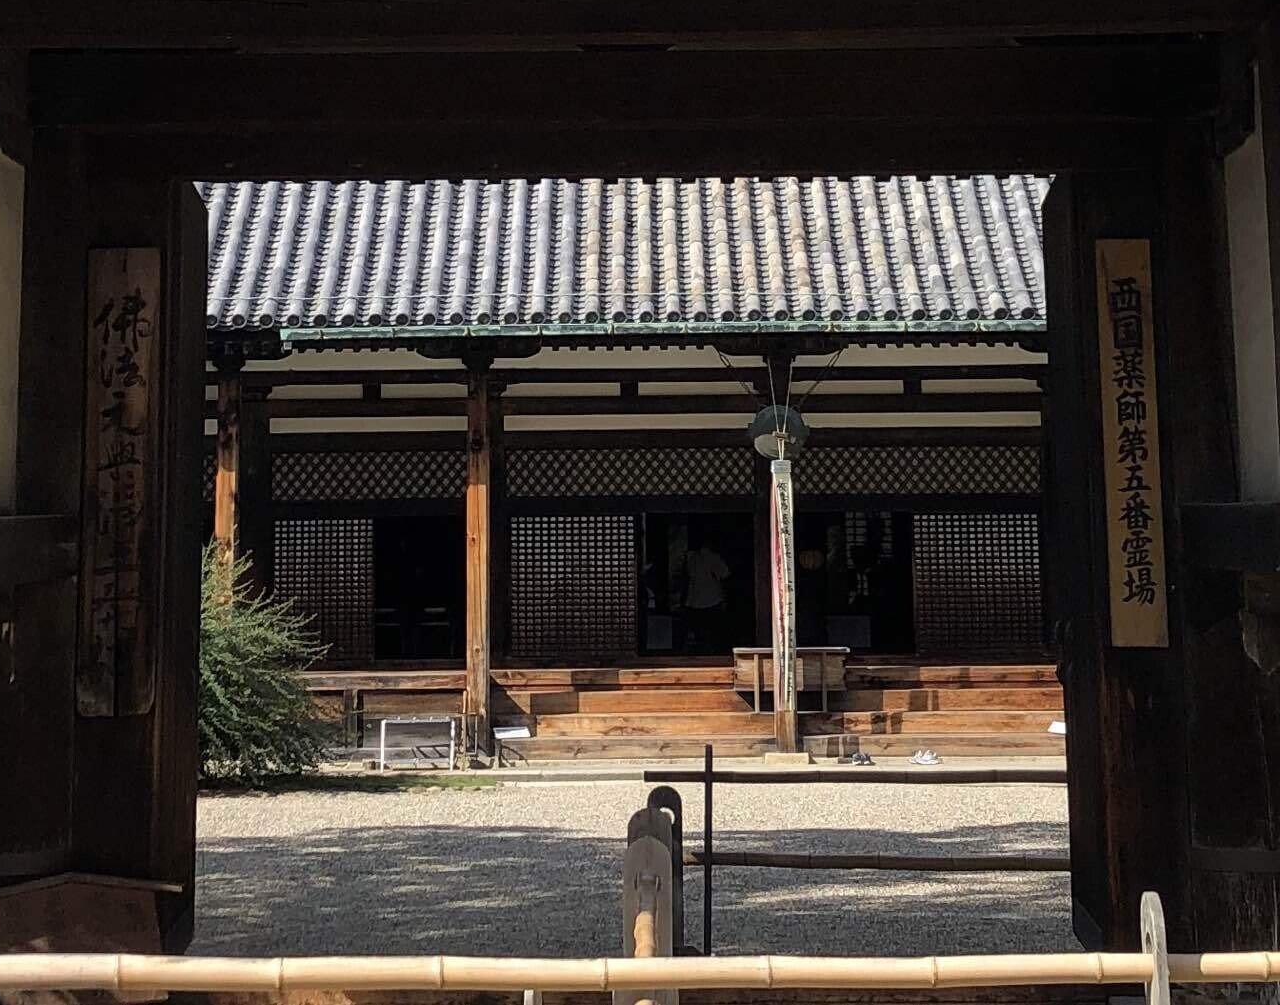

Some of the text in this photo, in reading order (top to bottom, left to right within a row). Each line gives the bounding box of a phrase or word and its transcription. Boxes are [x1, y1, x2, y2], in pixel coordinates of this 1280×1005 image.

[1106, 278, 1157, 606] 西国薬師第五番霊場
